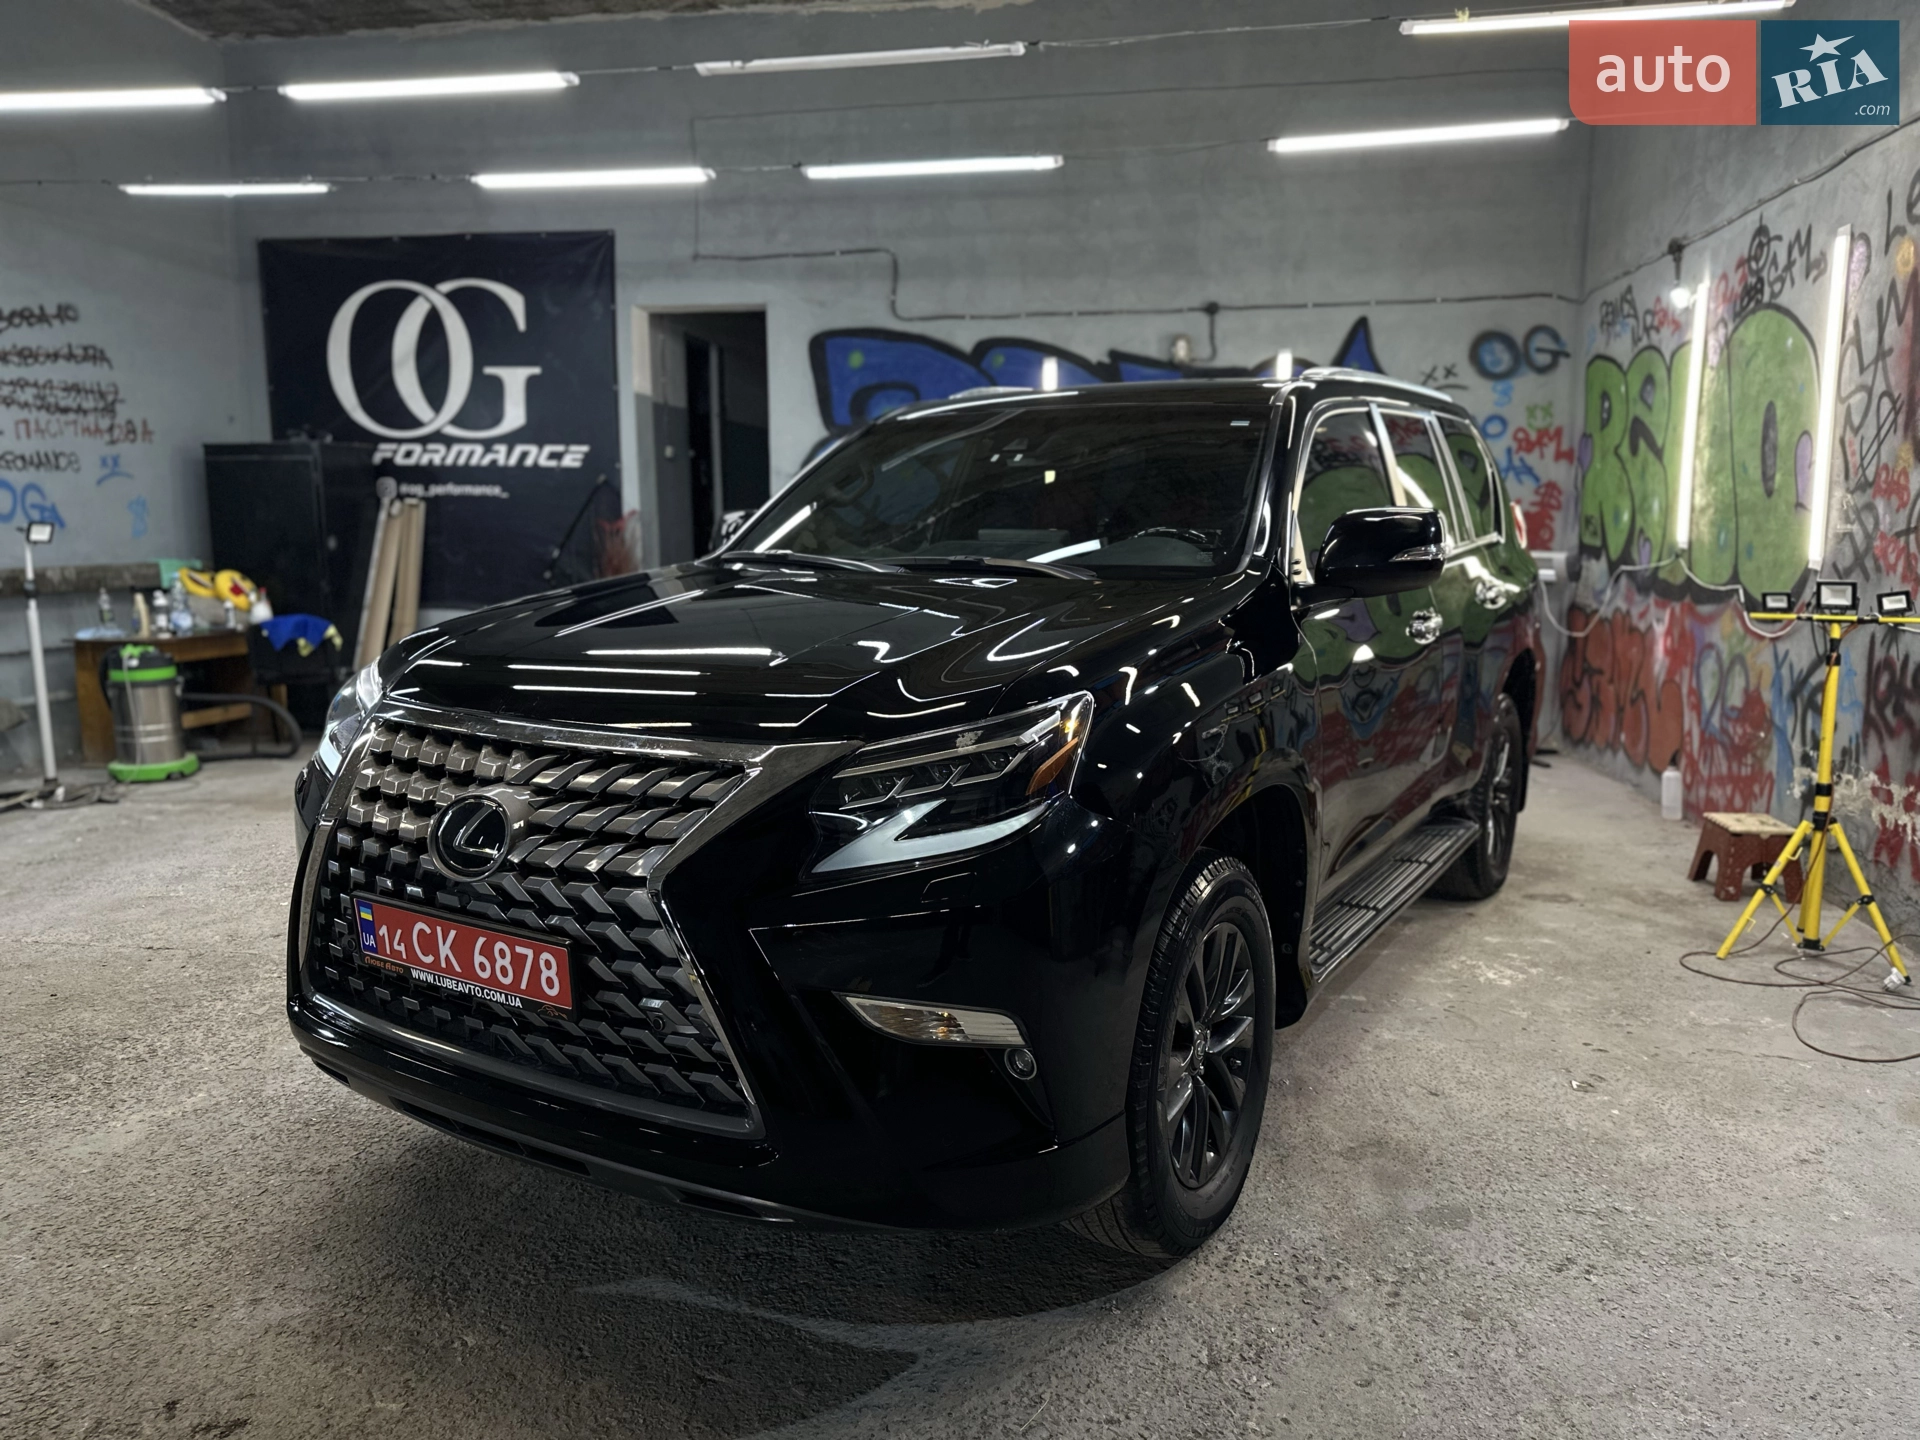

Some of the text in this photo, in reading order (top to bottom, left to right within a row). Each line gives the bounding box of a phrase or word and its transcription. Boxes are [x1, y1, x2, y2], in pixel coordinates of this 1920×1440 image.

[326, 277, 542, 440] OG
[363, 931, 376, 948] UA
[410, 968, 523, 1009] WWW.LUBEAVTO.COM.UA
[473, 936, 561, 997] 6878
